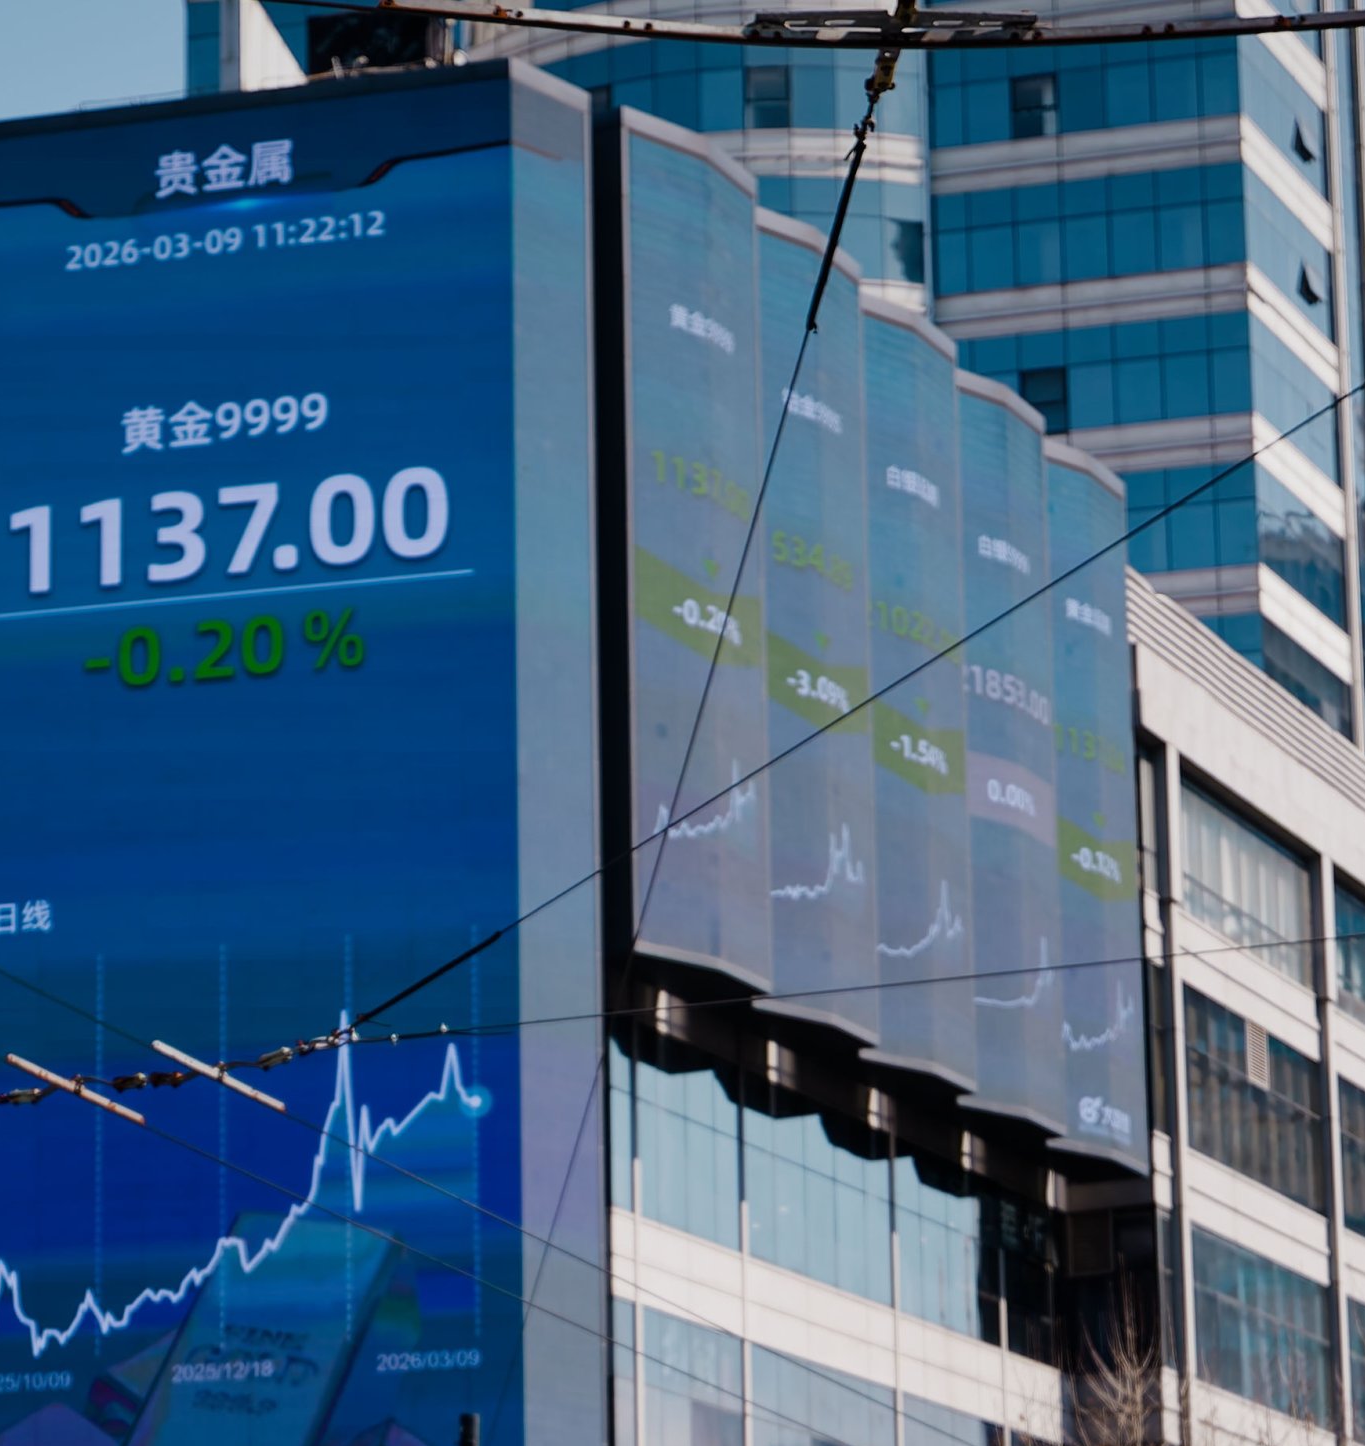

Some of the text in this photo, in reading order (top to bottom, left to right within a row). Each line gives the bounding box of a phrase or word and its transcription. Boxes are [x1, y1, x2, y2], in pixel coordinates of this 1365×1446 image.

[155, 139, 292, 198] 贵金属
[65, 210, 385, 271] 2026-03-09 11:22:12
[121, 392, 329, 454] 黄金9999
[8, 465, 450, 595] 1137.00
[376, 1349, 481, 1373] 2026/03/09
